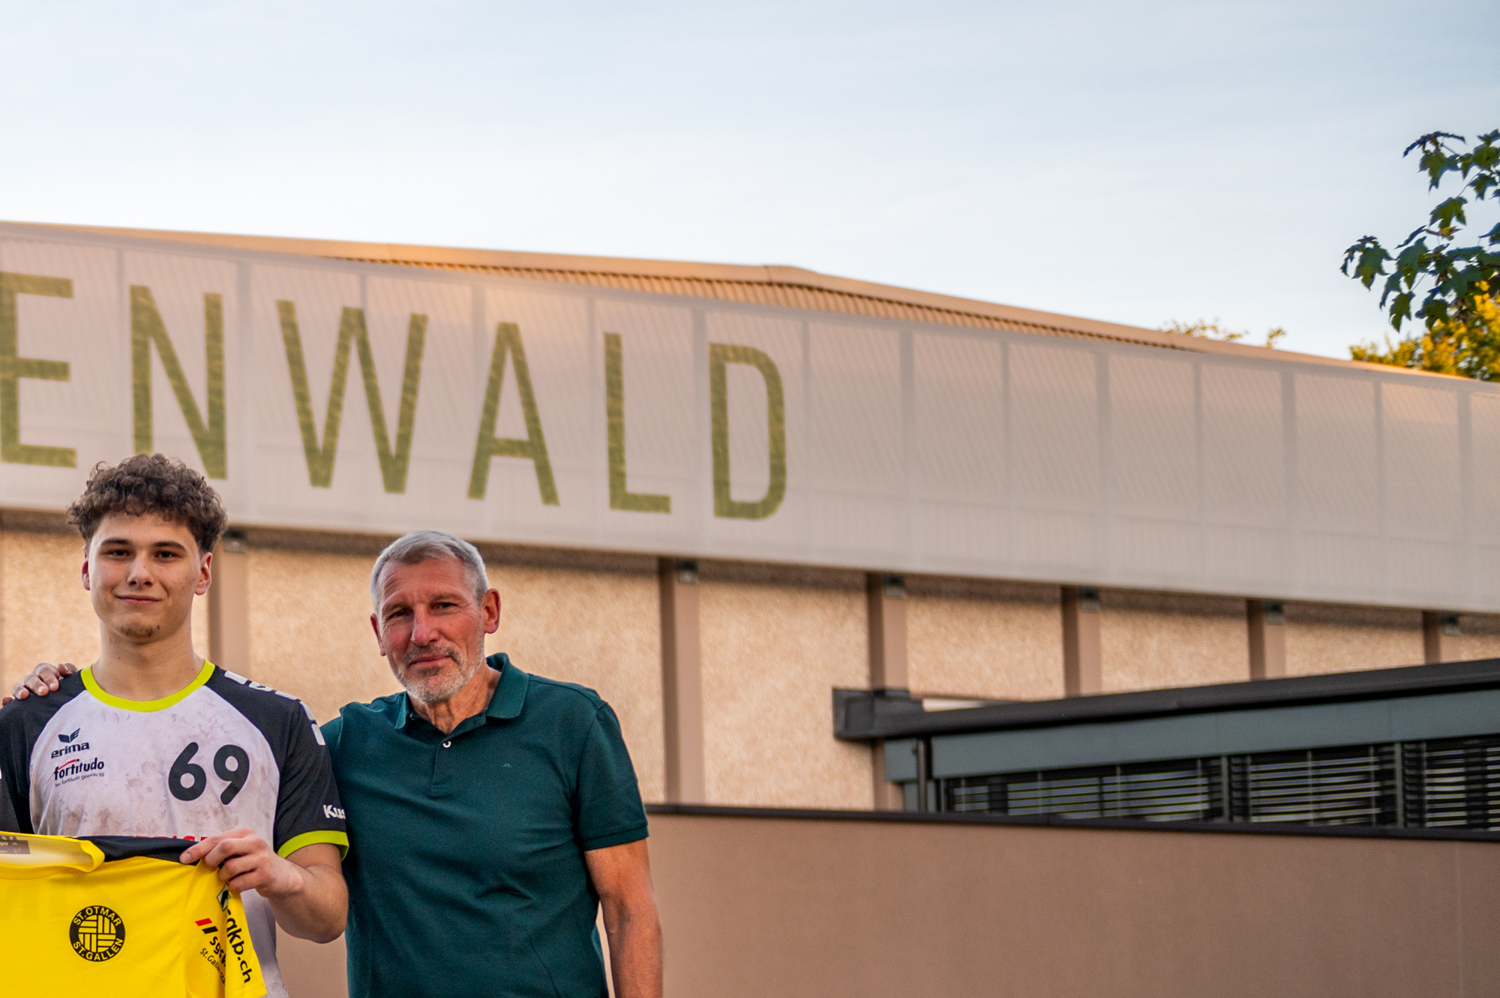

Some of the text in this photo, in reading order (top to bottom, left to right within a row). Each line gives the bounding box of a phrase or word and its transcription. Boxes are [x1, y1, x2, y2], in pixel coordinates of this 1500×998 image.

[51, 742, 90, 759] erima
[53, 757, 105, 781] fortitudo
[168, 742, 250, 805] 69
